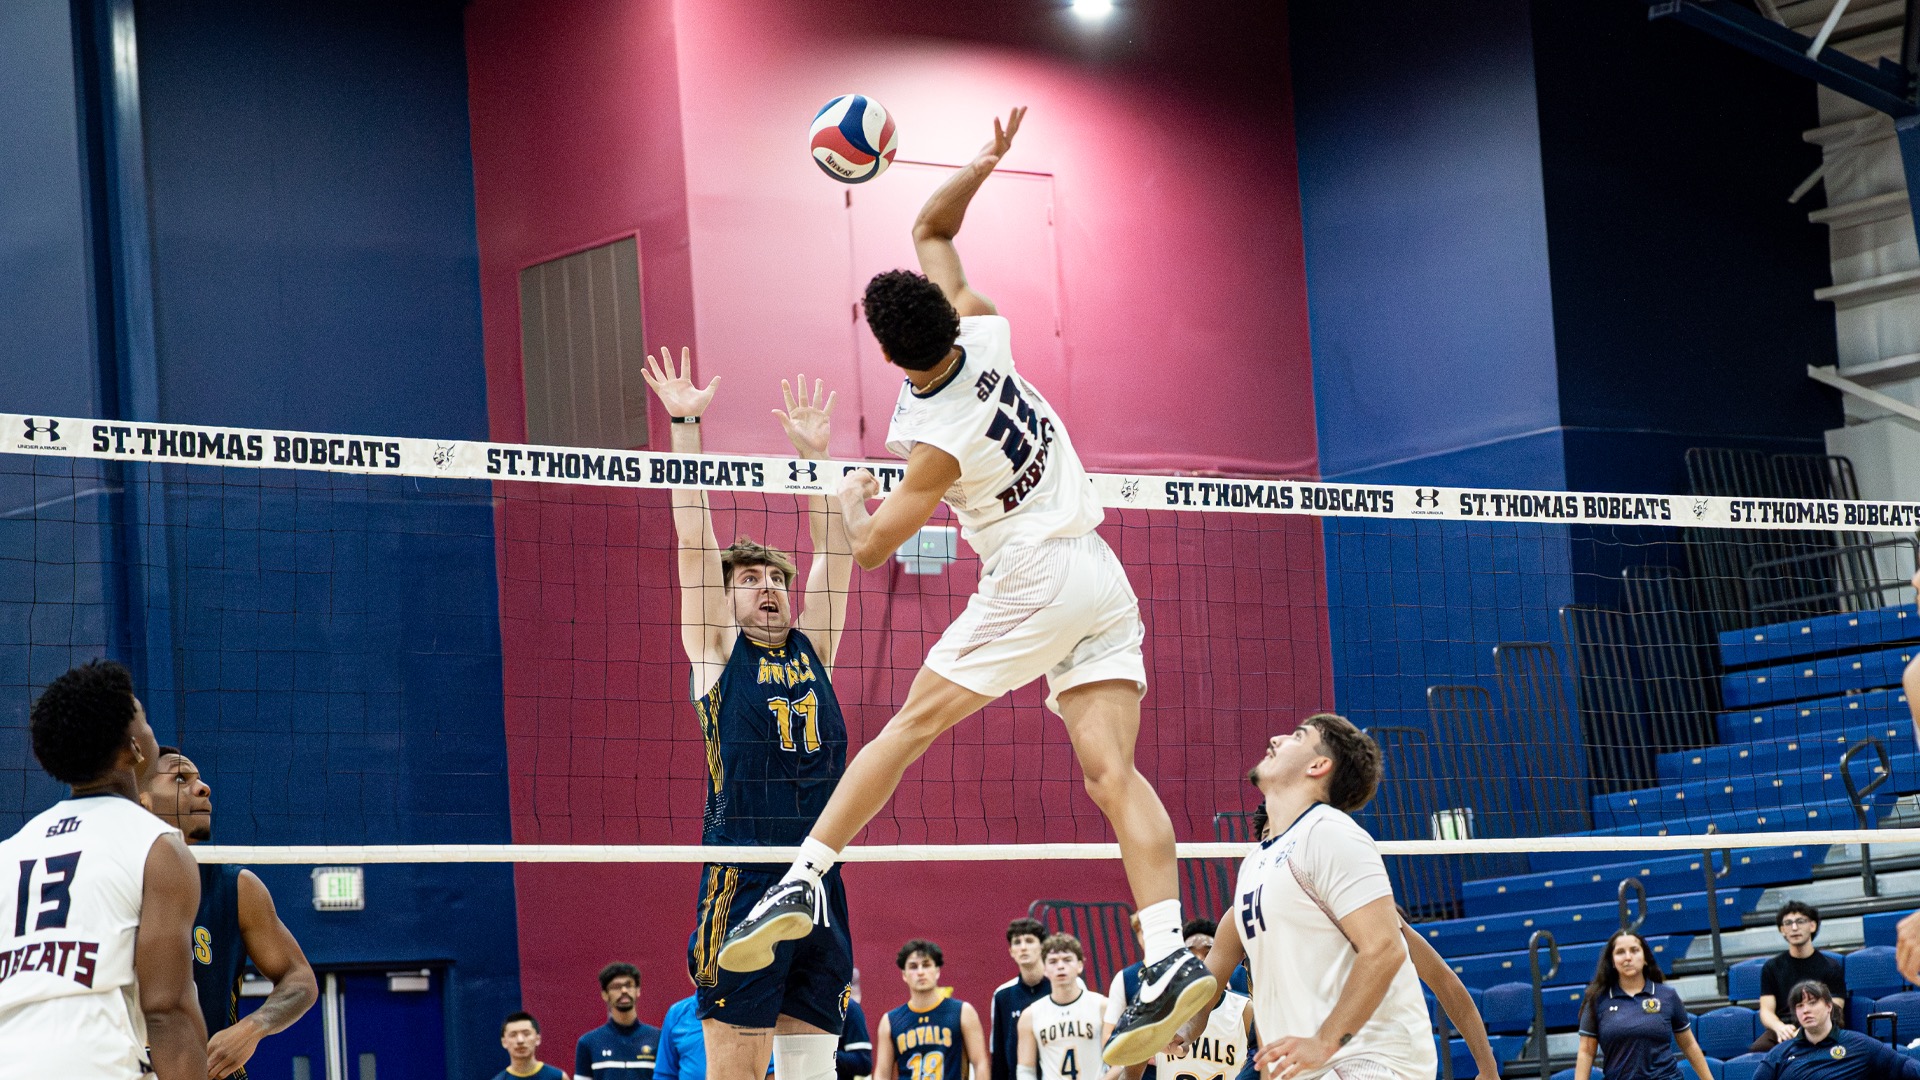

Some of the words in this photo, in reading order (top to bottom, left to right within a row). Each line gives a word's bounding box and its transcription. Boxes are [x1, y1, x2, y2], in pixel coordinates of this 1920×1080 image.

[273, 435, 401, 469] BOBCATS
[650, 458, 765, 488] BOBCATS
[1300, 486, 1394, 513] BOBCATS
[1584, 496, 1671, 521] BOBCATS
[1843, 503, 1920, 527] BOBCATS
[767, 688, 822, 753] 11
[14, 851, 82, 938] 13
[1242, 884, 1266, 940] 24
[0, 941, 100, 989] OBCATS
[897, 1025, 952, 1055] ROYALS
[1040, 1020, 1093, 1047] ROYALS
[1061, 1048, 1079, 1080] 4
[1167, 1036, 1236, 1067] YALS
